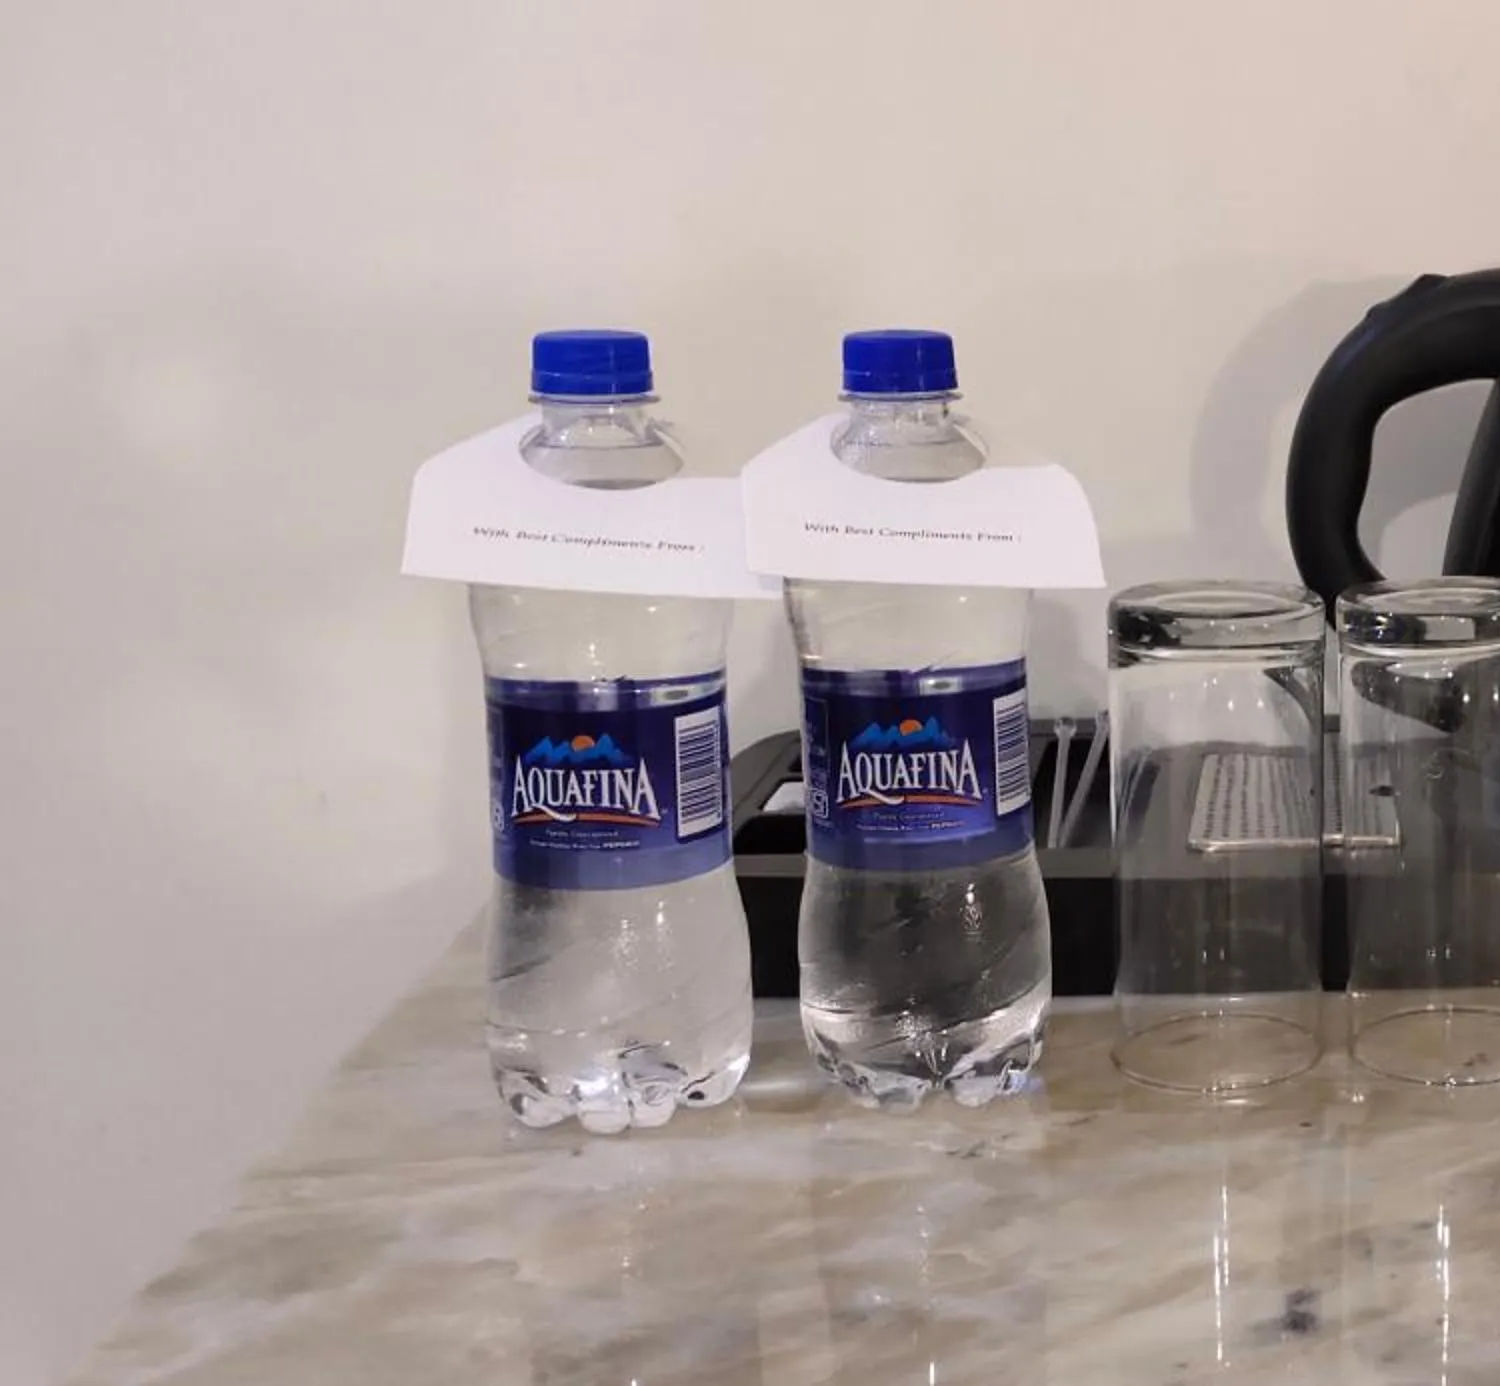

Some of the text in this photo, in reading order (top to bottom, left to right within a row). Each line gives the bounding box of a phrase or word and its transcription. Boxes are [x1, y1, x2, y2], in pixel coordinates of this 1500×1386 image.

[473, 526, 510, 539] With
[804, 521, 839, 534] With
[845, 524, 874, 536] Best
[879, 527, 972, 541] Compliments
[978, 532, 1014, 542] From
[511, 755, 662, 821] AQUAFINA
[836, 740, 983, 804] AQUAFINA
